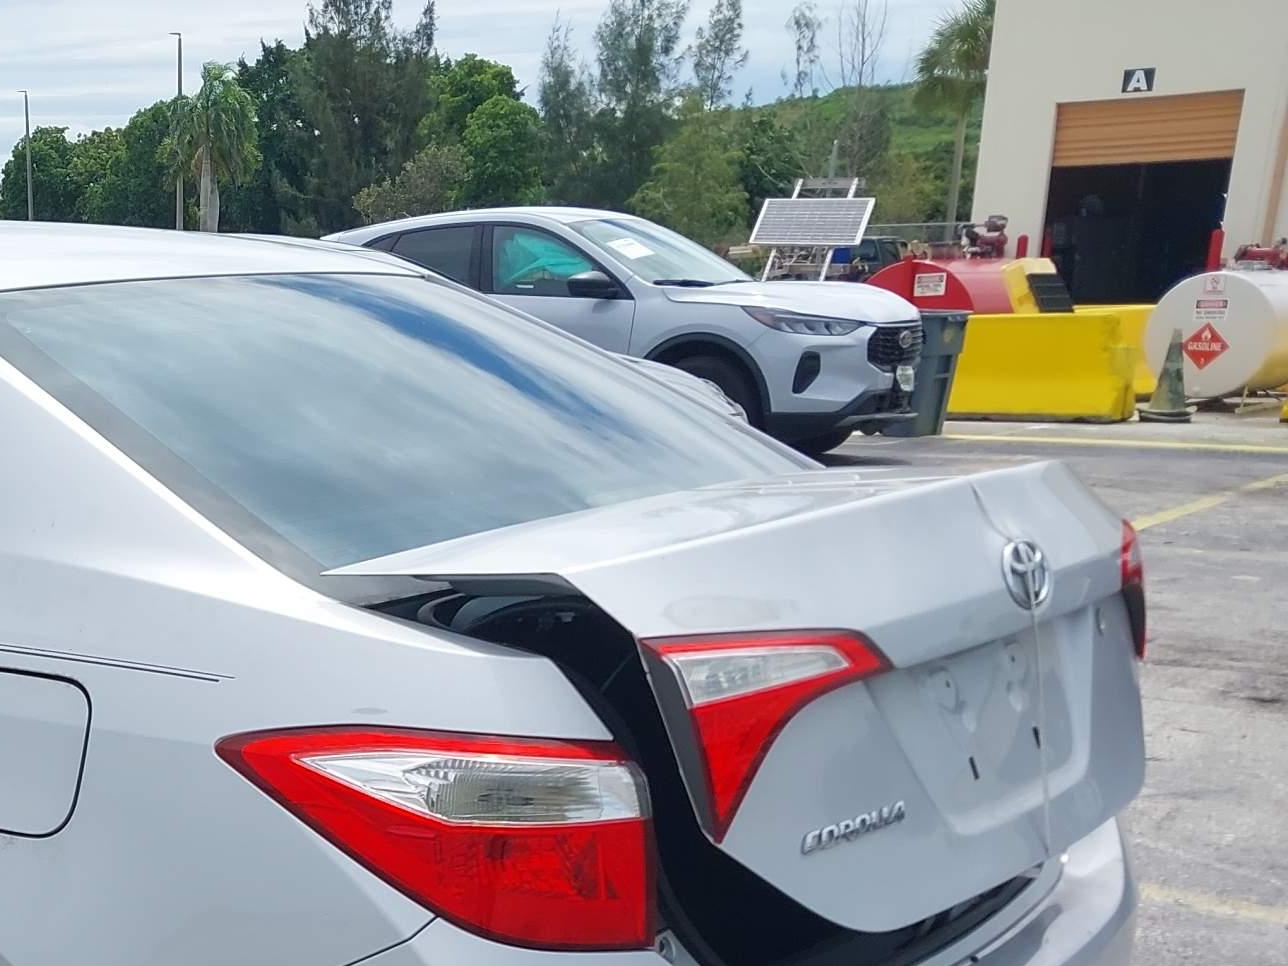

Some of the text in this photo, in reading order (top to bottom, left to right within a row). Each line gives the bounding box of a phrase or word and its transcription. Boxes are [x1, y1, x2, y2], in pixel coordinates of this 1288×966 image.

[1127, 70, 1148, 91] A
[1187, 340, 1223, 352] GASOLINE
[800, 799, 906, 856] COROLLA
